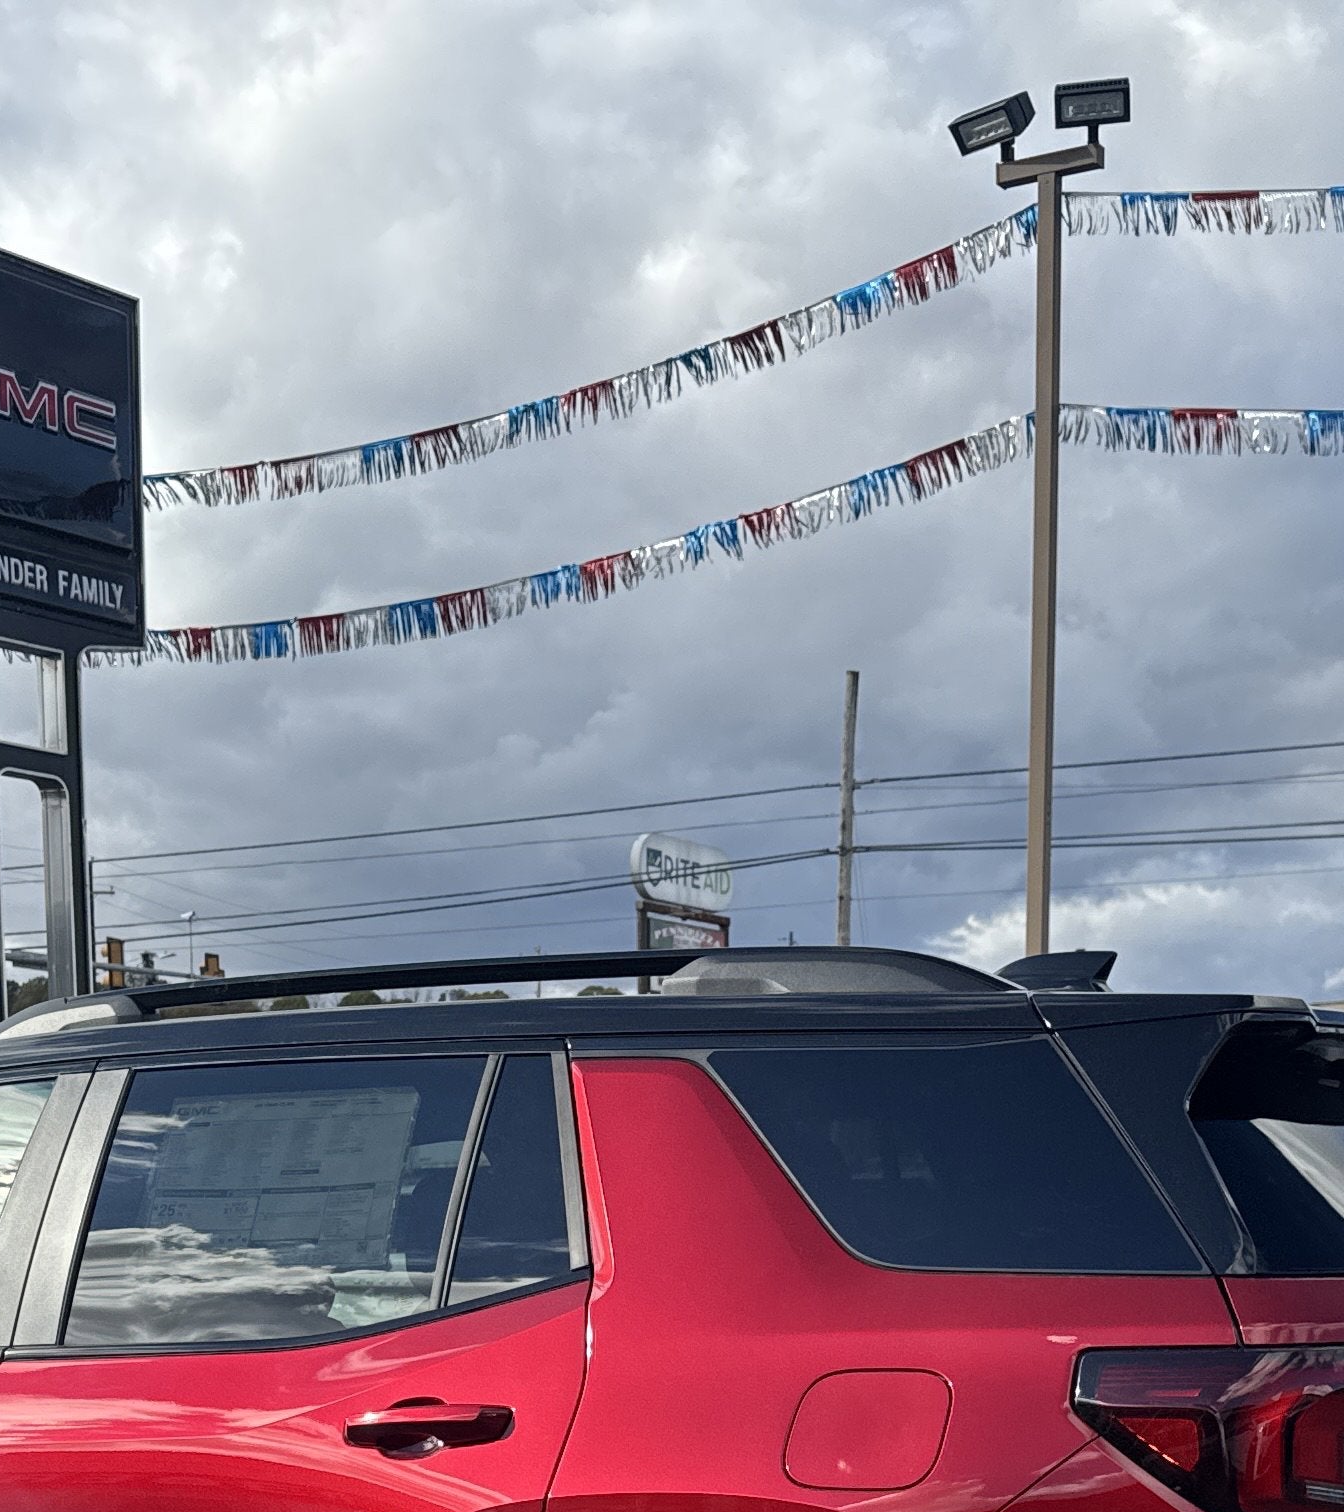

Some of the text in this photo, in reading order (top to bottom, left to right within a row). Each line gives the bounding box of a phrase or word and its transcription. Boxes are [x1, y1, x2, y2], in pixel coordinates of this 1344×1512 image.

[58, 569, 125, 610] FAMILY
[664, 855, 731, 895] RITE AID
[177, 1105, 220, 1116] GMC
